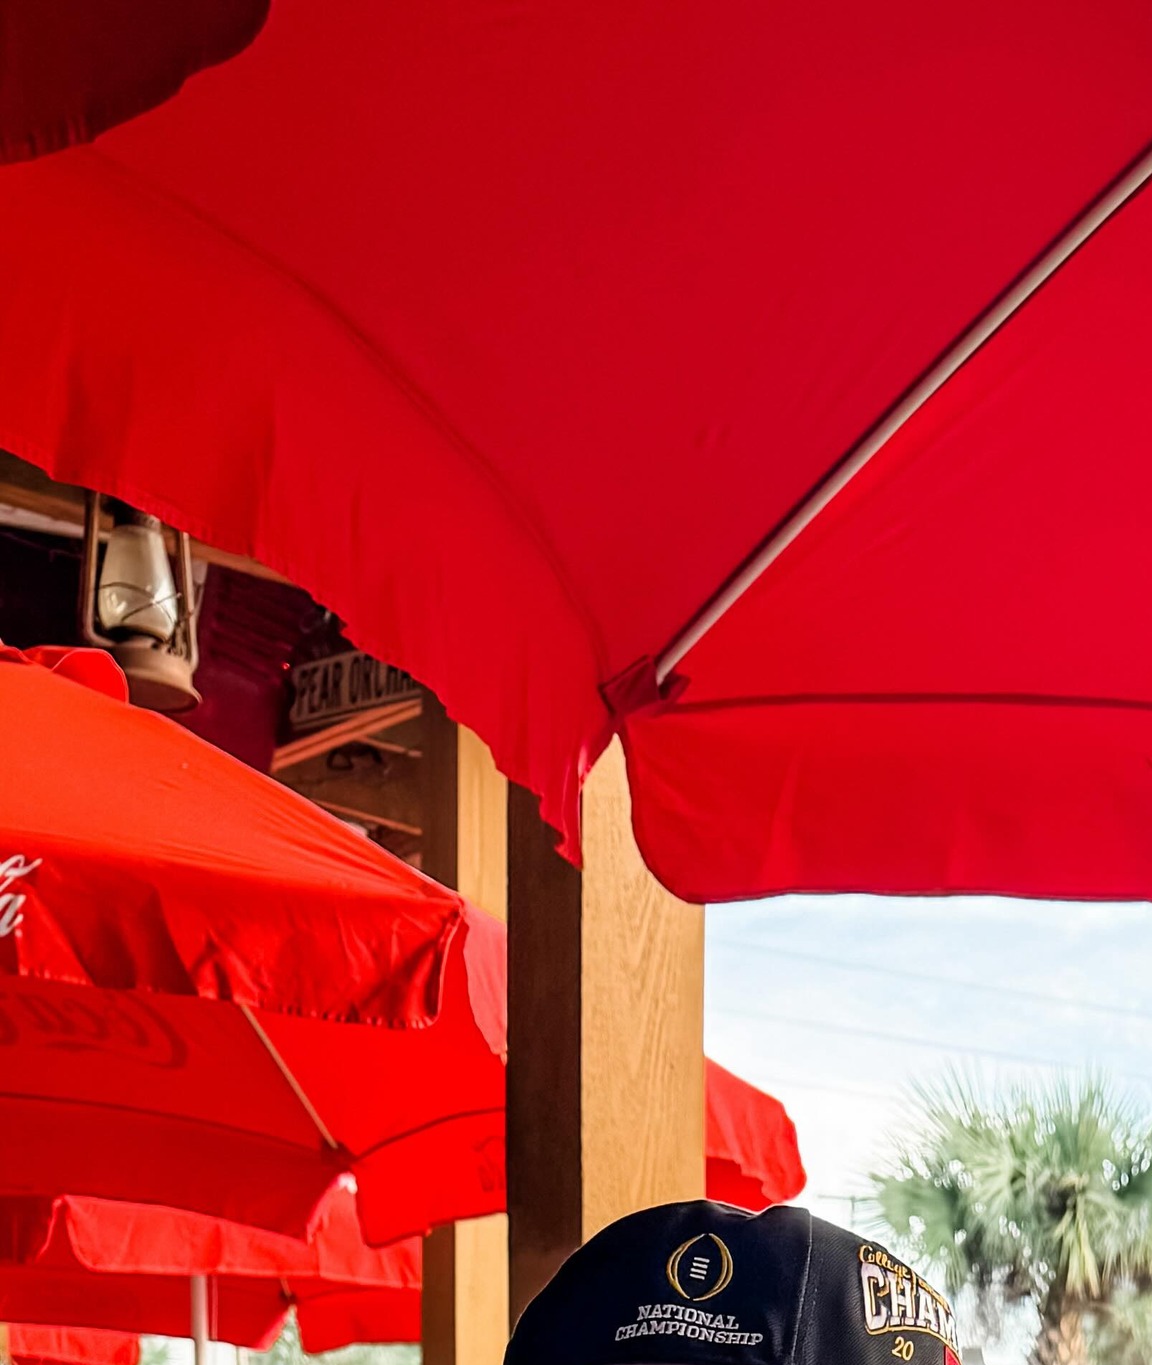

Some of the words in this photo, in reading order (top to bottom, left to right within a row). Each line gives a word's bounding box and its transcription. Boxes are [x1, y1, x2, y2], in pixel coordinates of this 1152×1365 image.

[296, 661, 343, 718] PEAR
[859, 1245, 912, 1288] College
[637, 1304, 739, 1330] NATIONAL
[615, 1320, 763, 1345] CHAMPIONSHIP
[891, 1336, 914, 1361] 20
